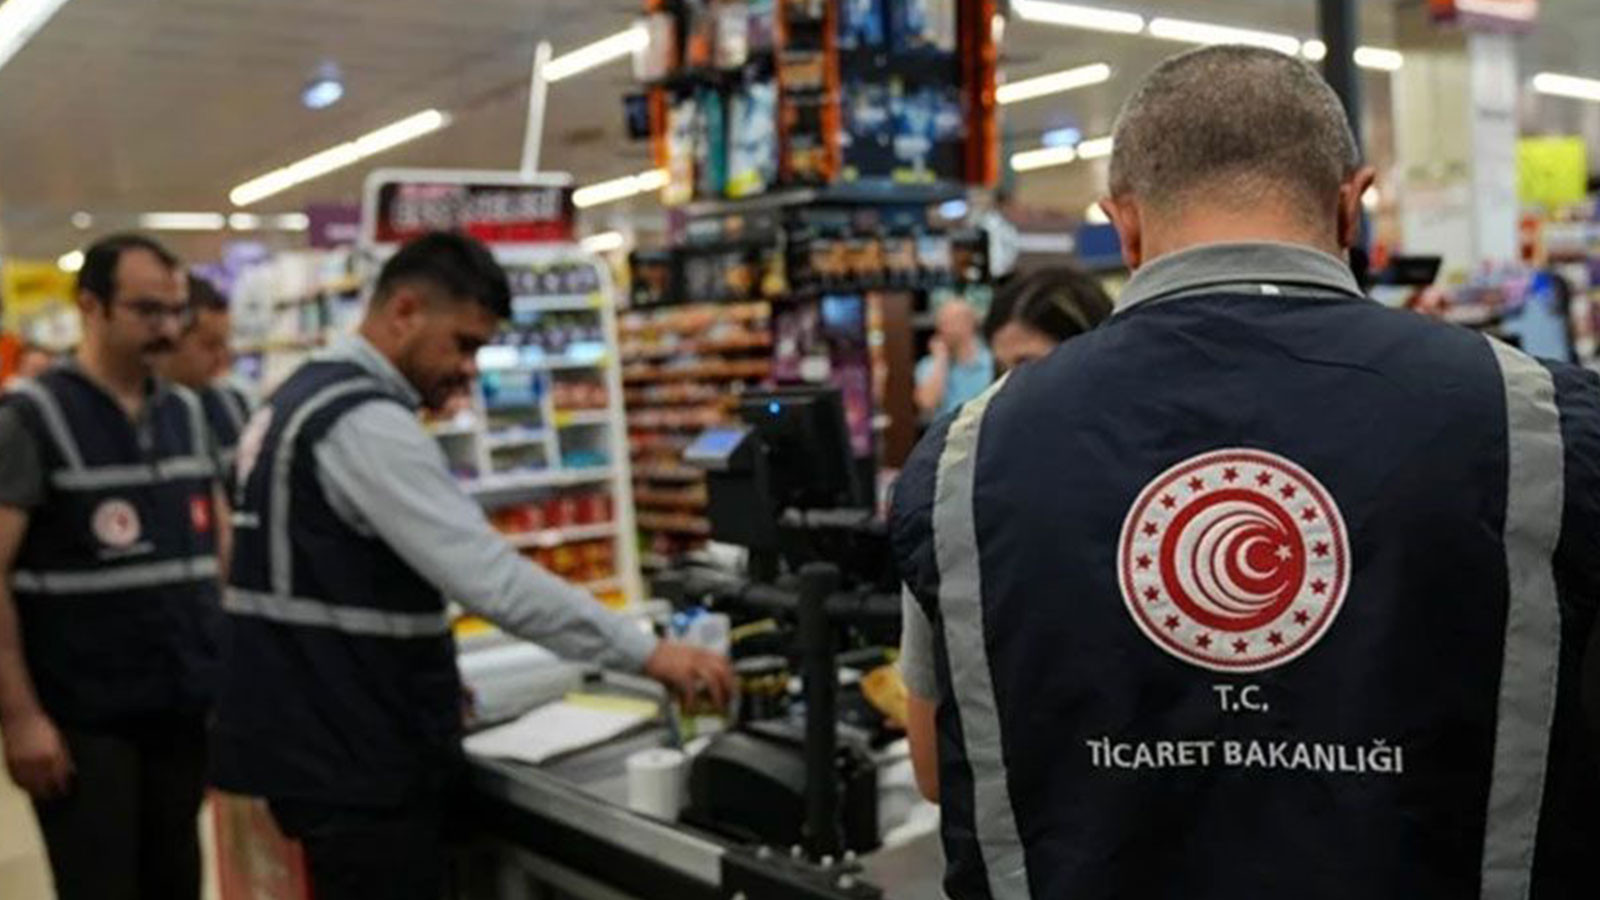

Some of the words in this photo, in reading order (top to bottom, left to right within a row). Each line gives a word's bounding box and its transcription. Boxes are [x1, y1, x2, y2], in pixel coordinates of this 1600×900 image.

[1213, 685, 1269, 711] T.C.
[1086, 737, 1215, 769] TİCARET
[1224, 738, 1403, 773] BAKANLIĞI
